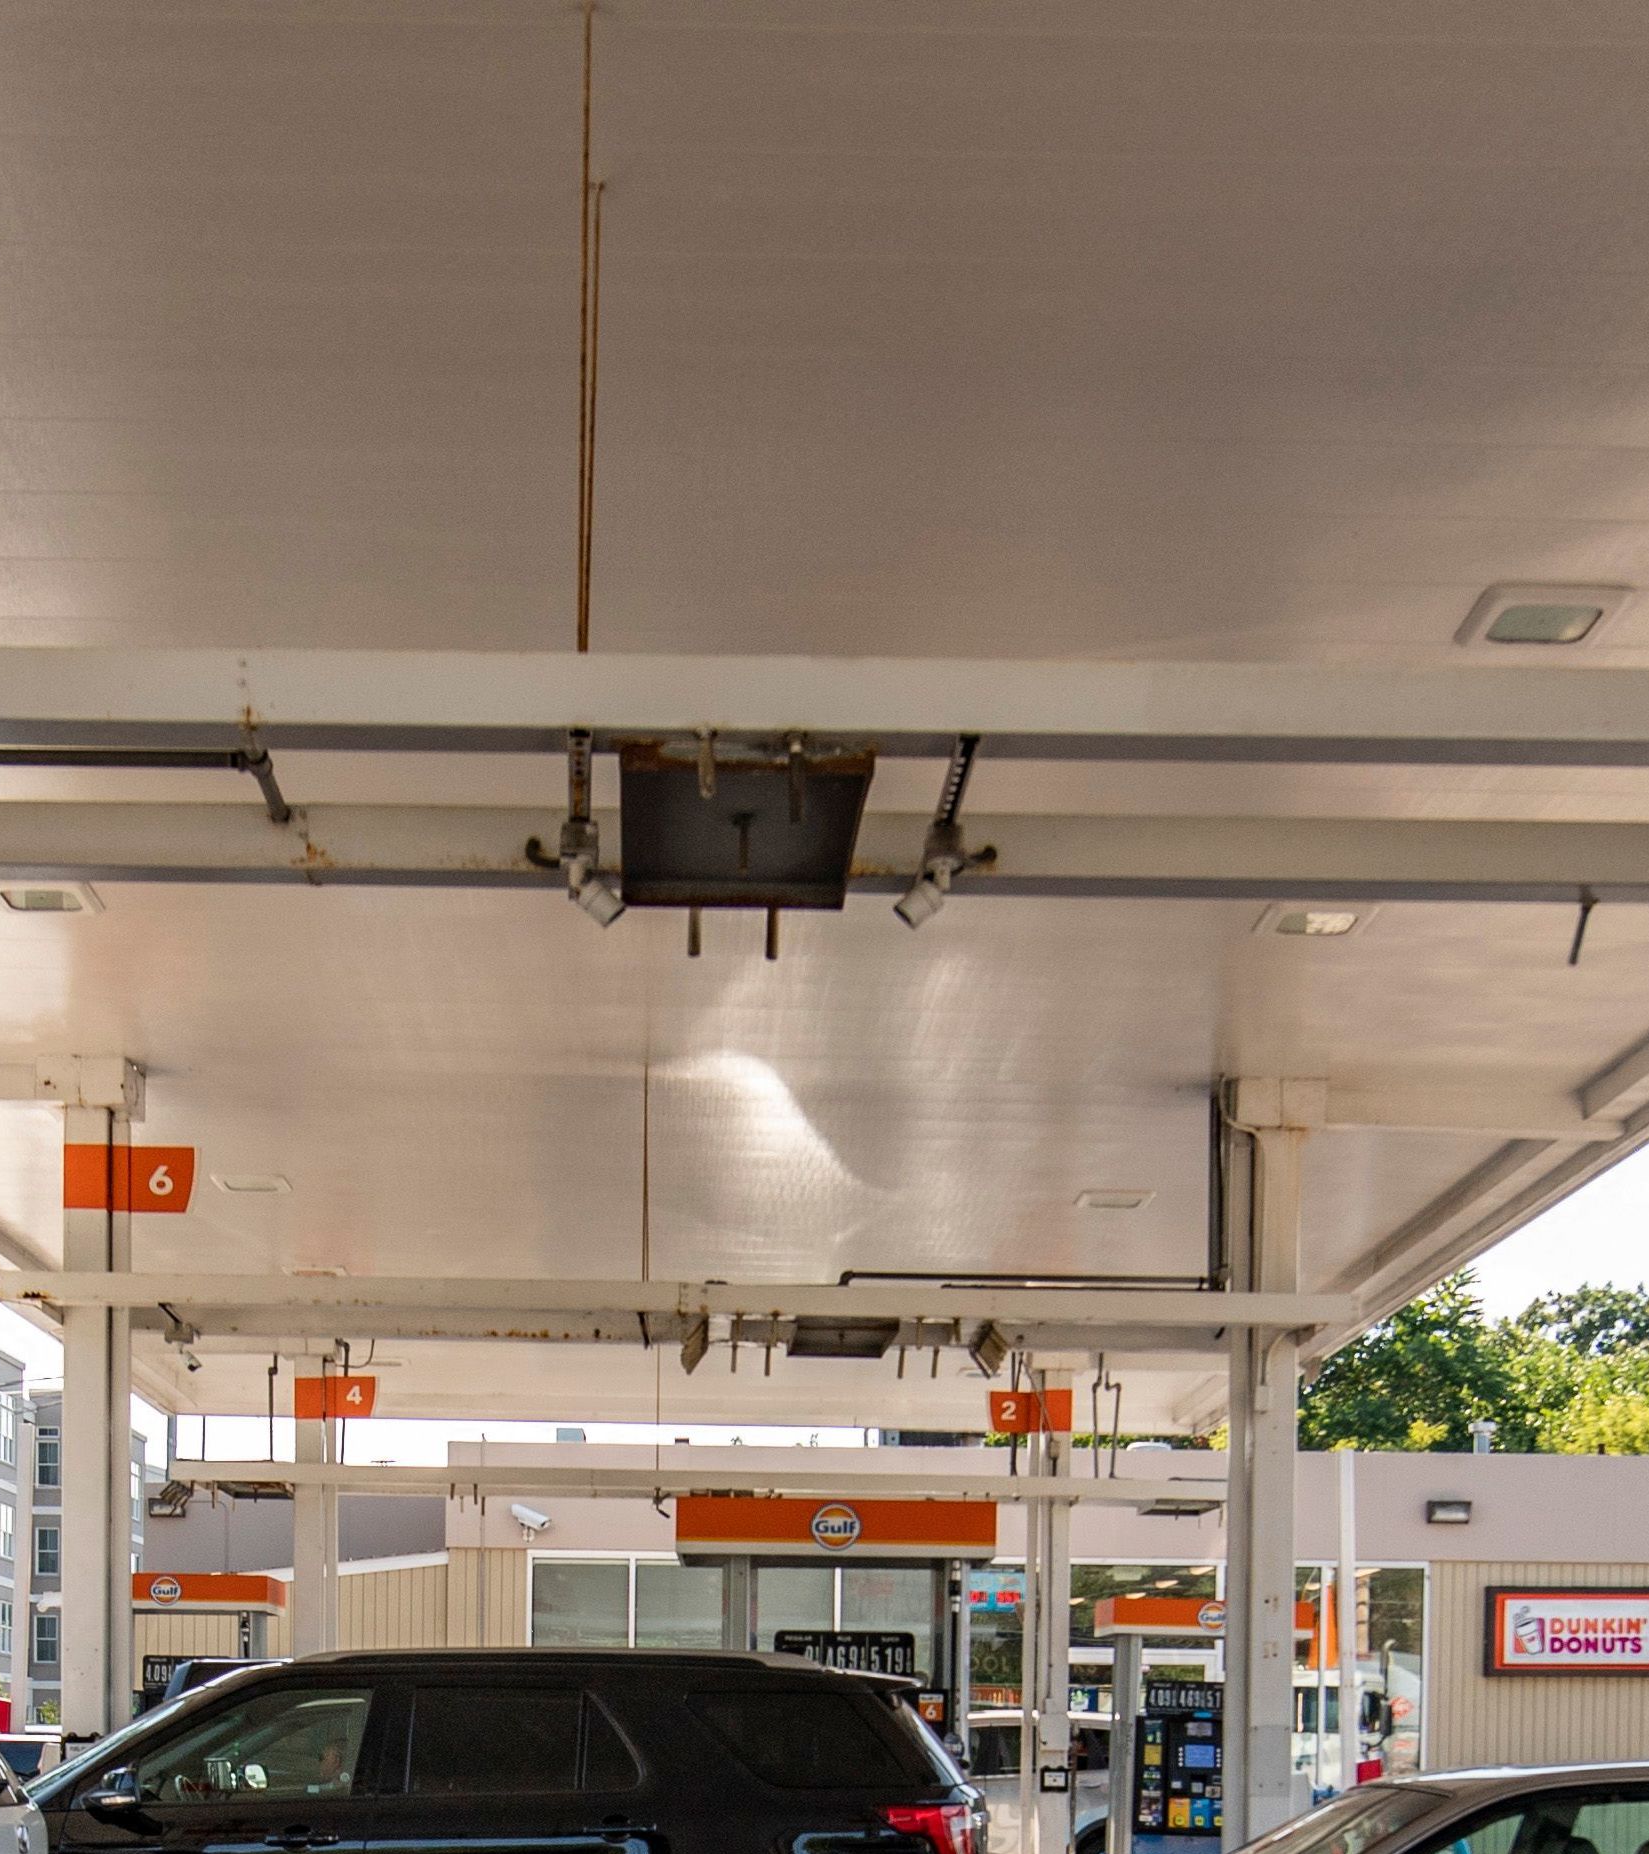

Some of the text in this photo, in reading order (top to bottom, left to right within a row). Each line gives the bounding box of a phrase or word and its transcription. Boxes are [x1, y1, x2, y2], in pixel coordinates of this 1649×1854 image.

[148, 1164, 174, 1196] 6
[345, 1384, 363, 1406] 4
[1000, 1400, 1017, 1421] 2
[814, 1519, 857, 1535] Gulf
[153, 1587, 178, 1596] Gulf
[1550, 1618, 1647, 1635] DUNKIN'
[1550, 1637, 1642, 1653] DONUTS
